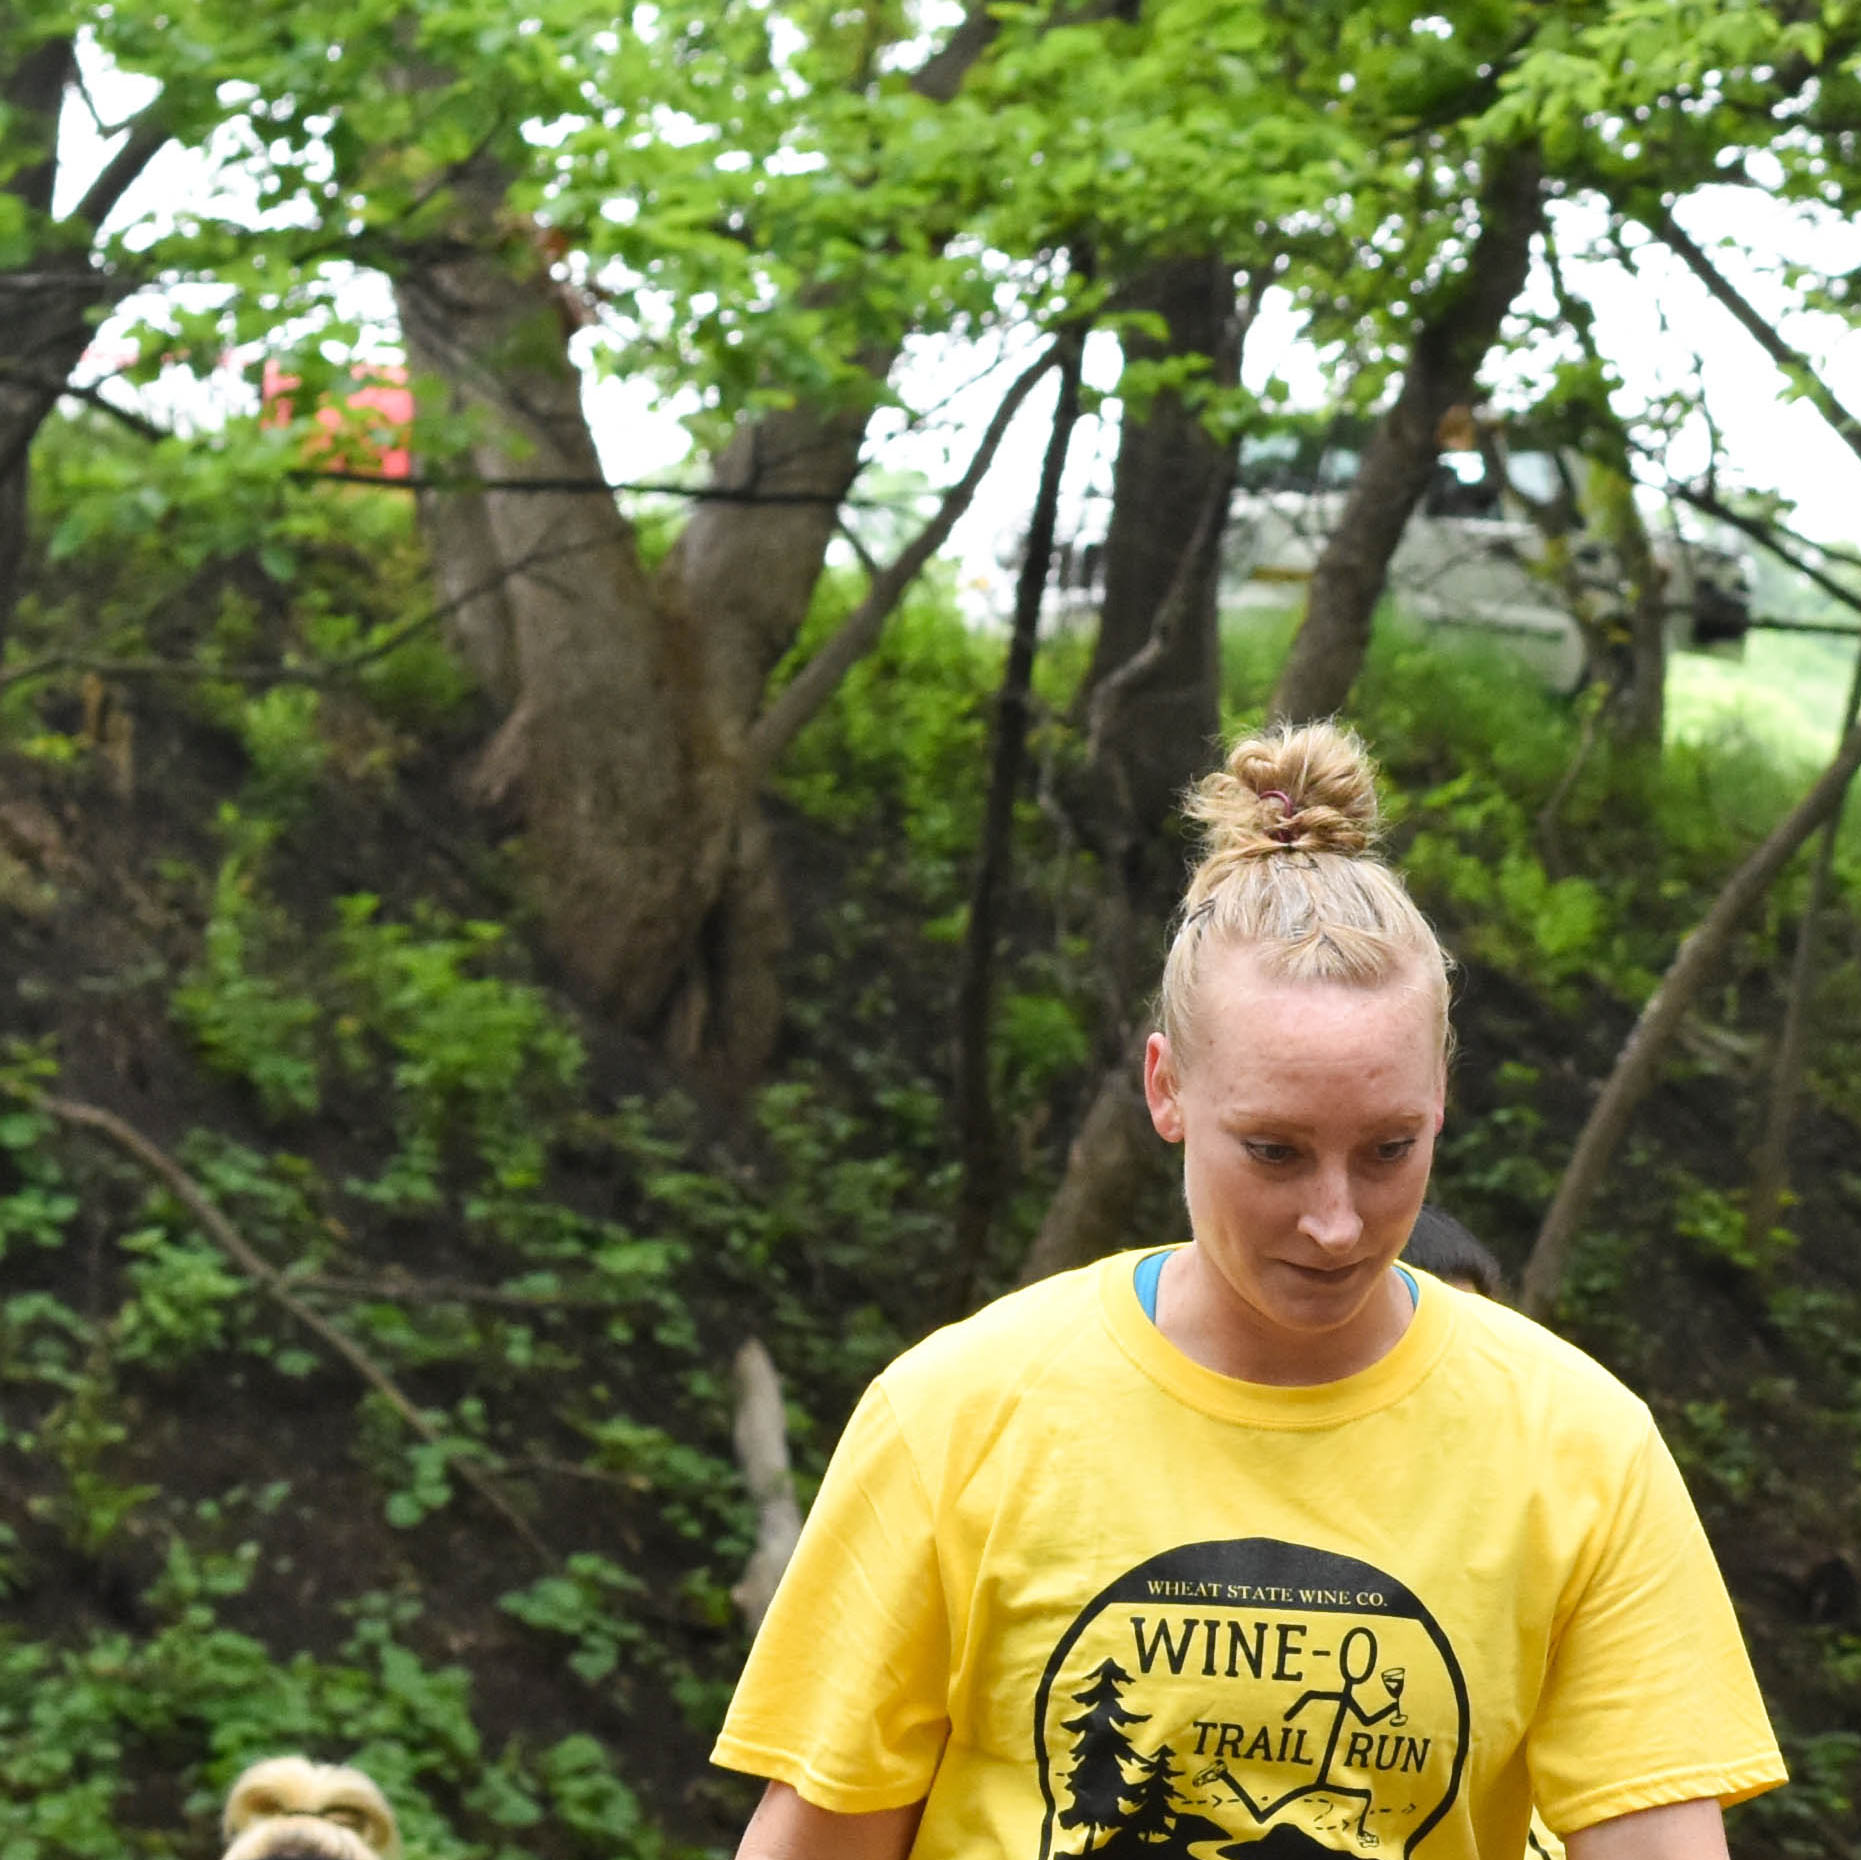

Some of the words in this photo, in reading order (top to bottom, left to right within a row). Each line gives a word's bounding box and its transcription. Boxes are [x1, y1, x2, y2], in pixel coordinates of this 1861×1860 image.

[1147, 1580, 1222, 1598] WHEAT
[1227, 1584, 1294, 1602] STATE
[1299, 1588, 1351, 1606] WINE
[1355, 1591, 1388, 1607] CO.
[1130, 1616, 1378, 1684] WINE-O
[1193, 1721, 1314, 1766] TRAIL
[1344, 1731, 1431, 1774] RUN
